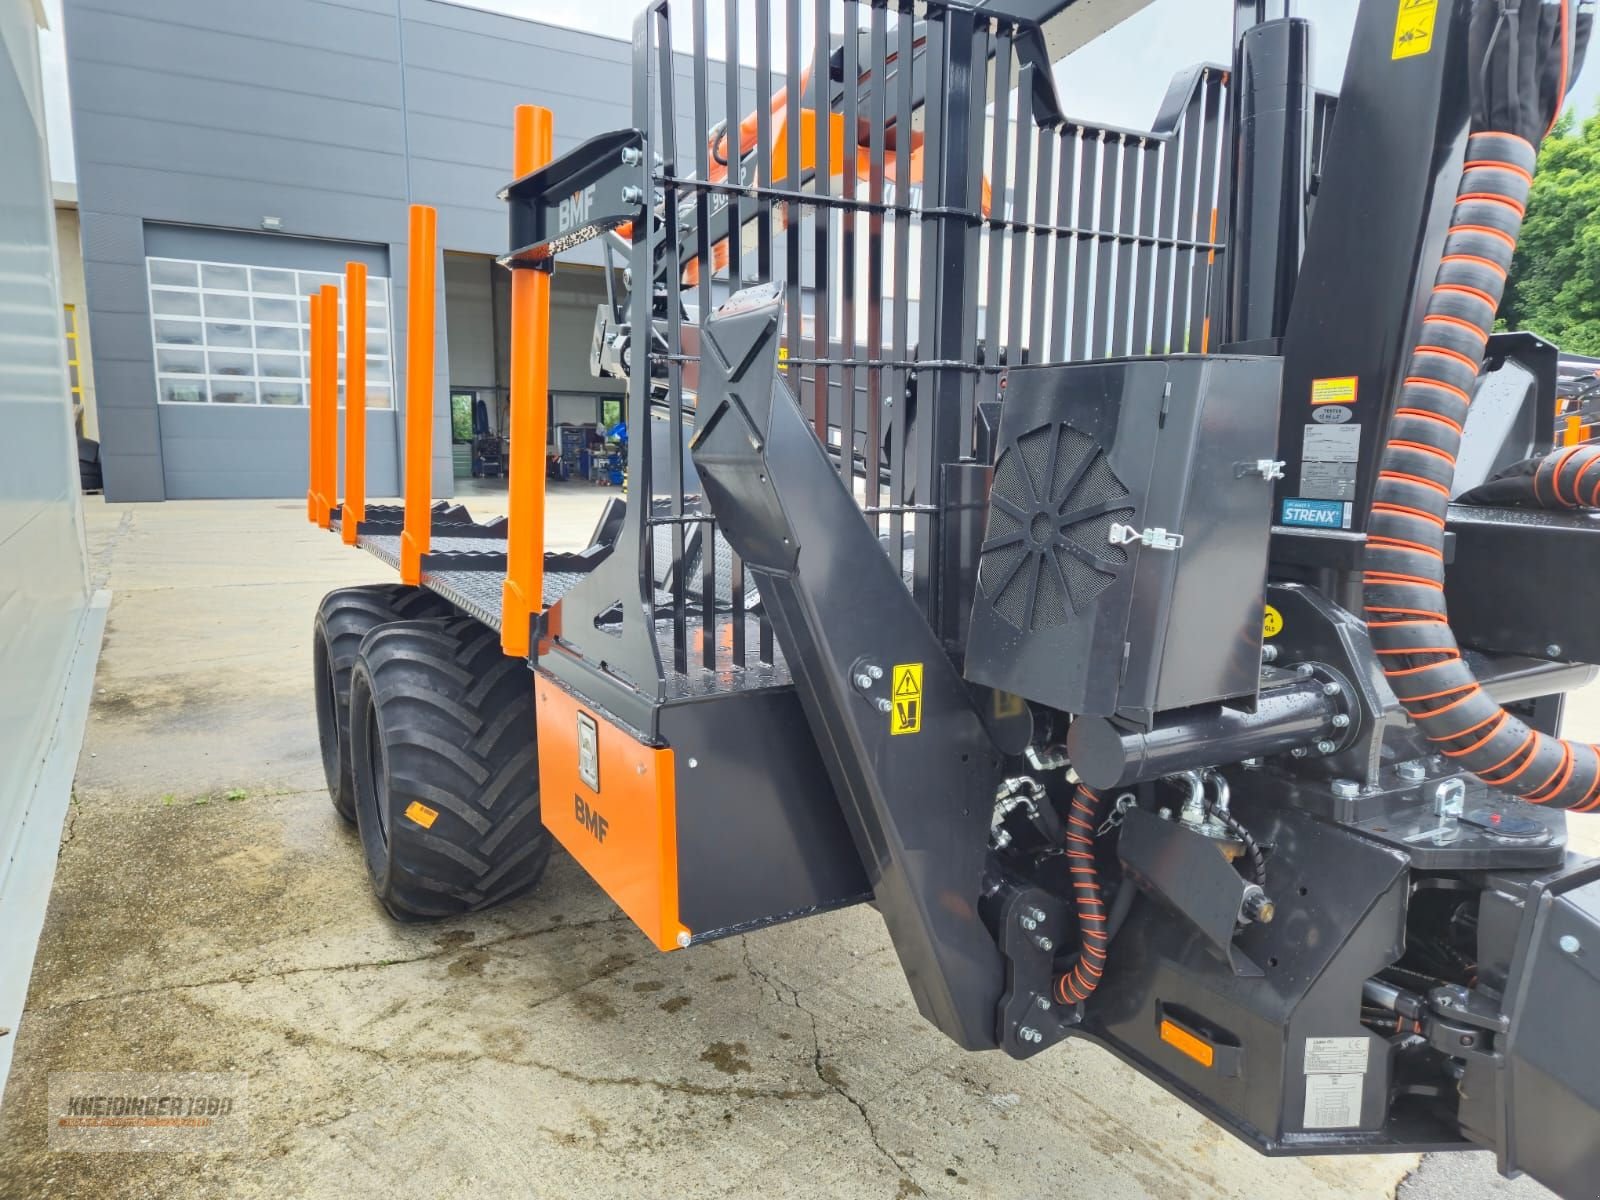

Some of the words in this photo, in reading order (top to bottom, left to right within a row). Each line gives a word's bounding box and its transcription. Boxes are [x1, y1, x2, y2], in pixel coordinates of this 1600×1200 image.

[559, 183, 596, 232] BMF
[1285, 507, 1336, 523] STRENX
[574, 792, 609, 844] BMF
